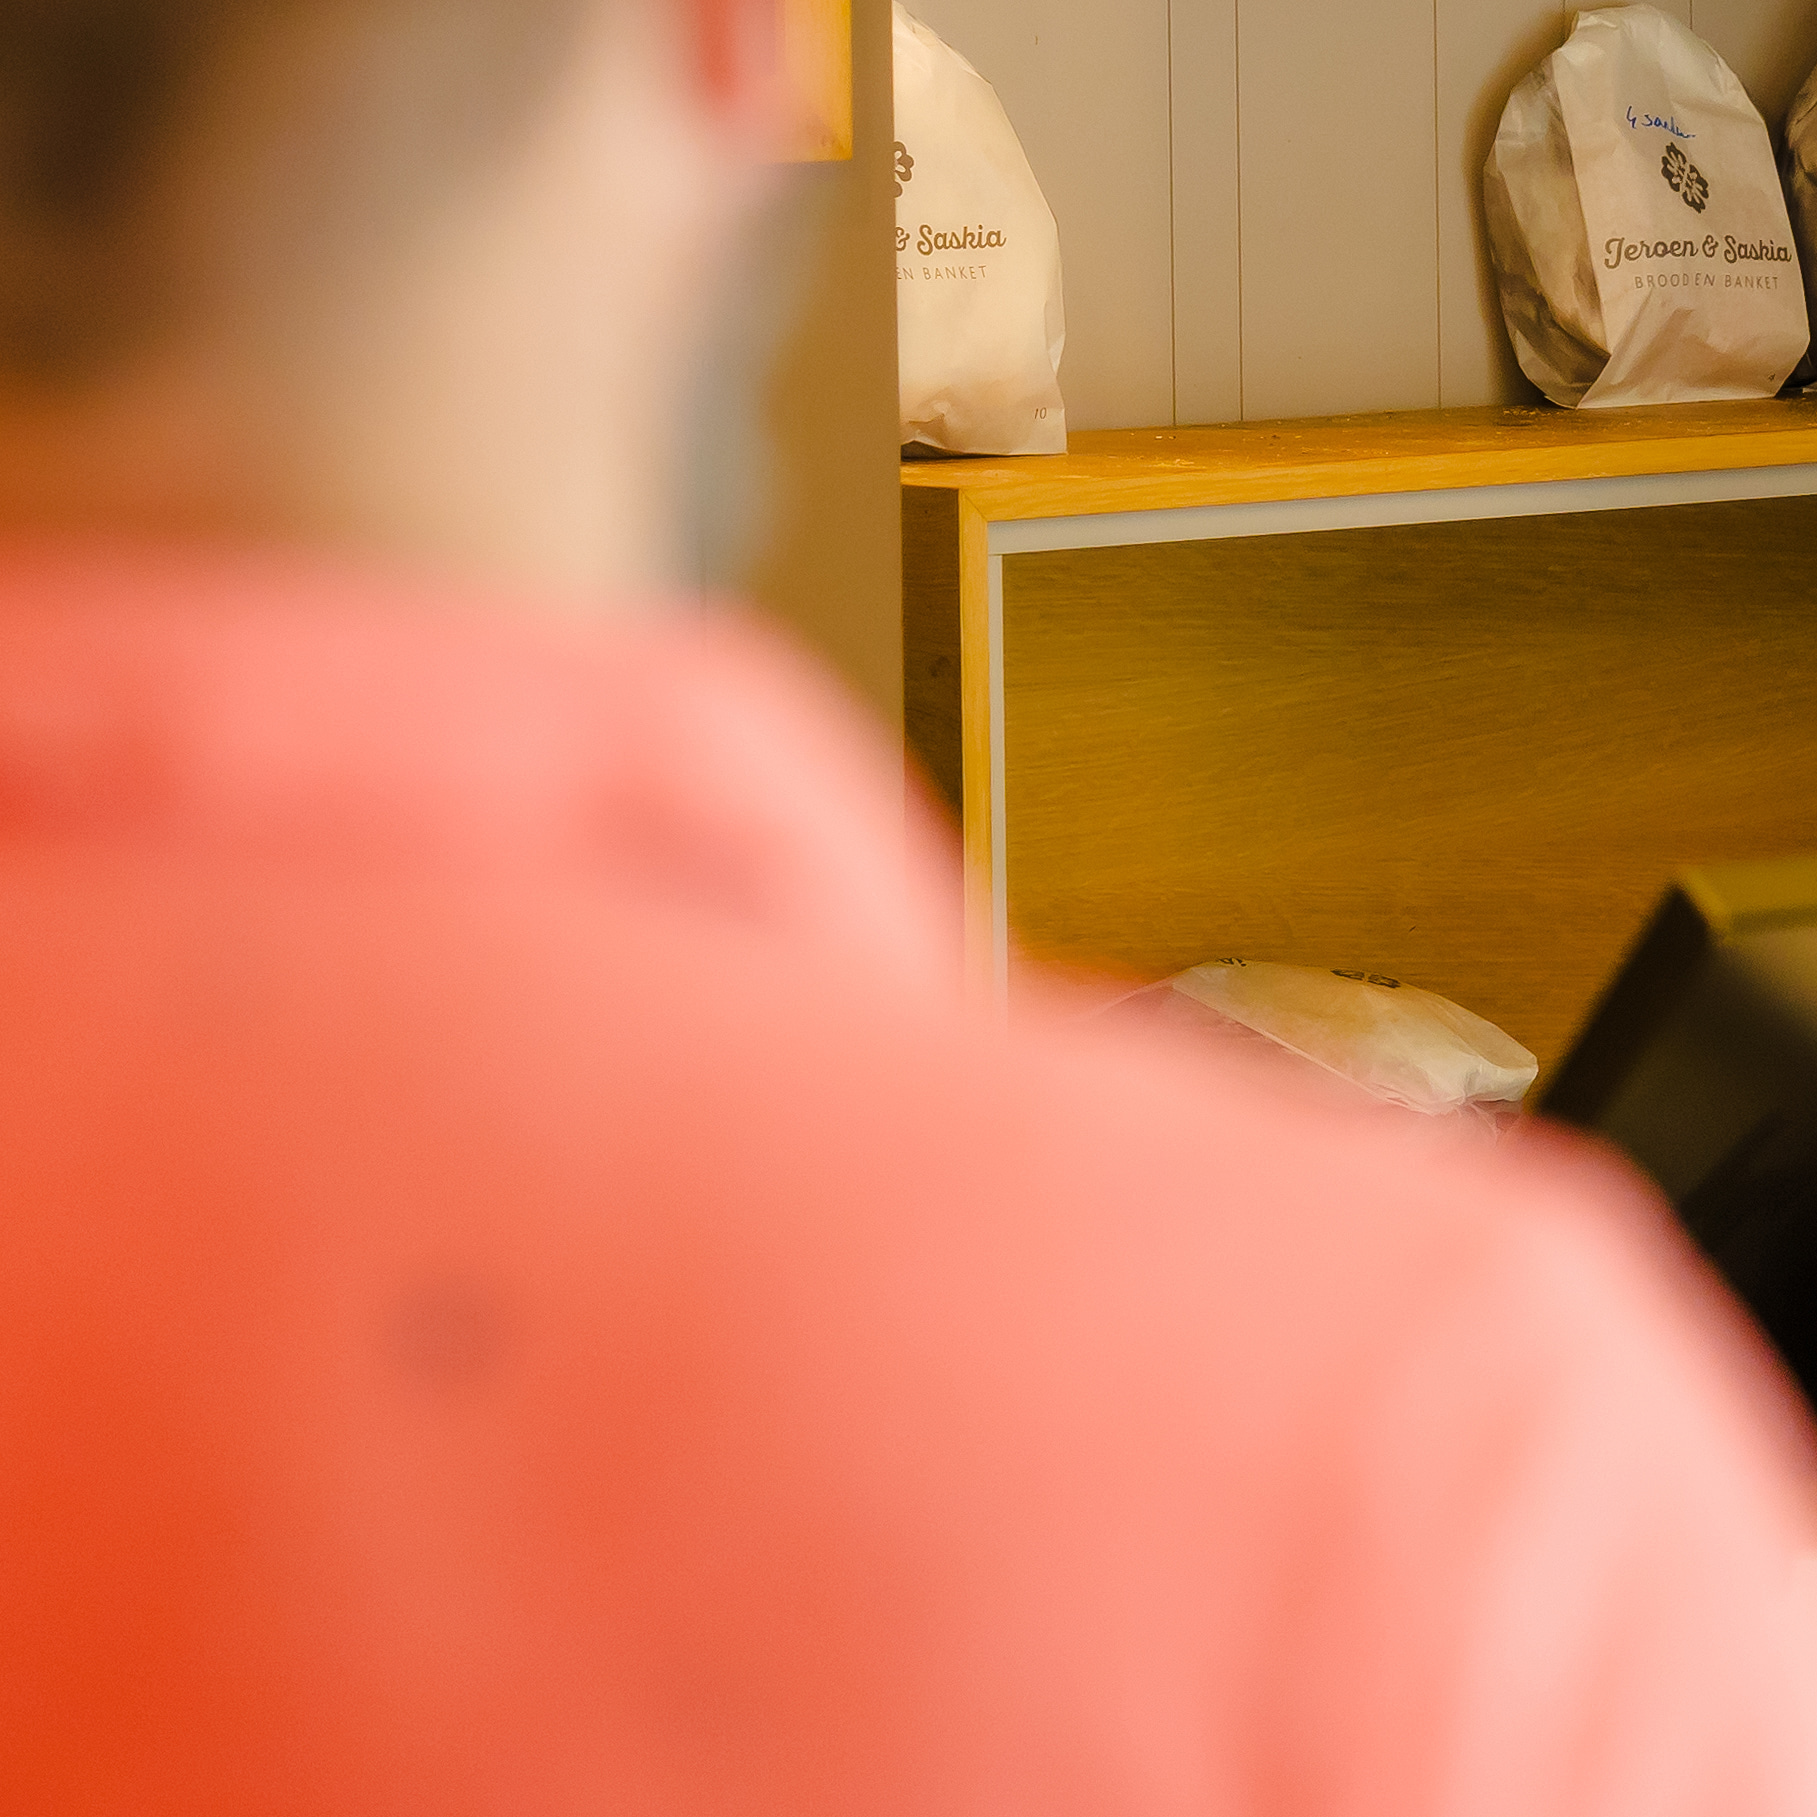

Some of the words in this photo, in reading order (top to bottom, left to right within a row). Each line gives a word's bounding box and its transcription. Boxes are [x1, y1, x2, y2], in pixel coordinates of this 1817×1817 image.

[895, 226, 910, 252] &
[917, 224, 1007, 256] Saskia
[1604, 237, 1698, 269] Jeroen
[1702, 235, 1719, 258] &
[1724, 235, 1792, 263] Saskia
[923, 265, 986, 280] BANKET
[1635, 273, 1689, 289] BROOD
[1695, 273, 1716, 287] EN
[1724, 274, 1778, 289] BANKET
